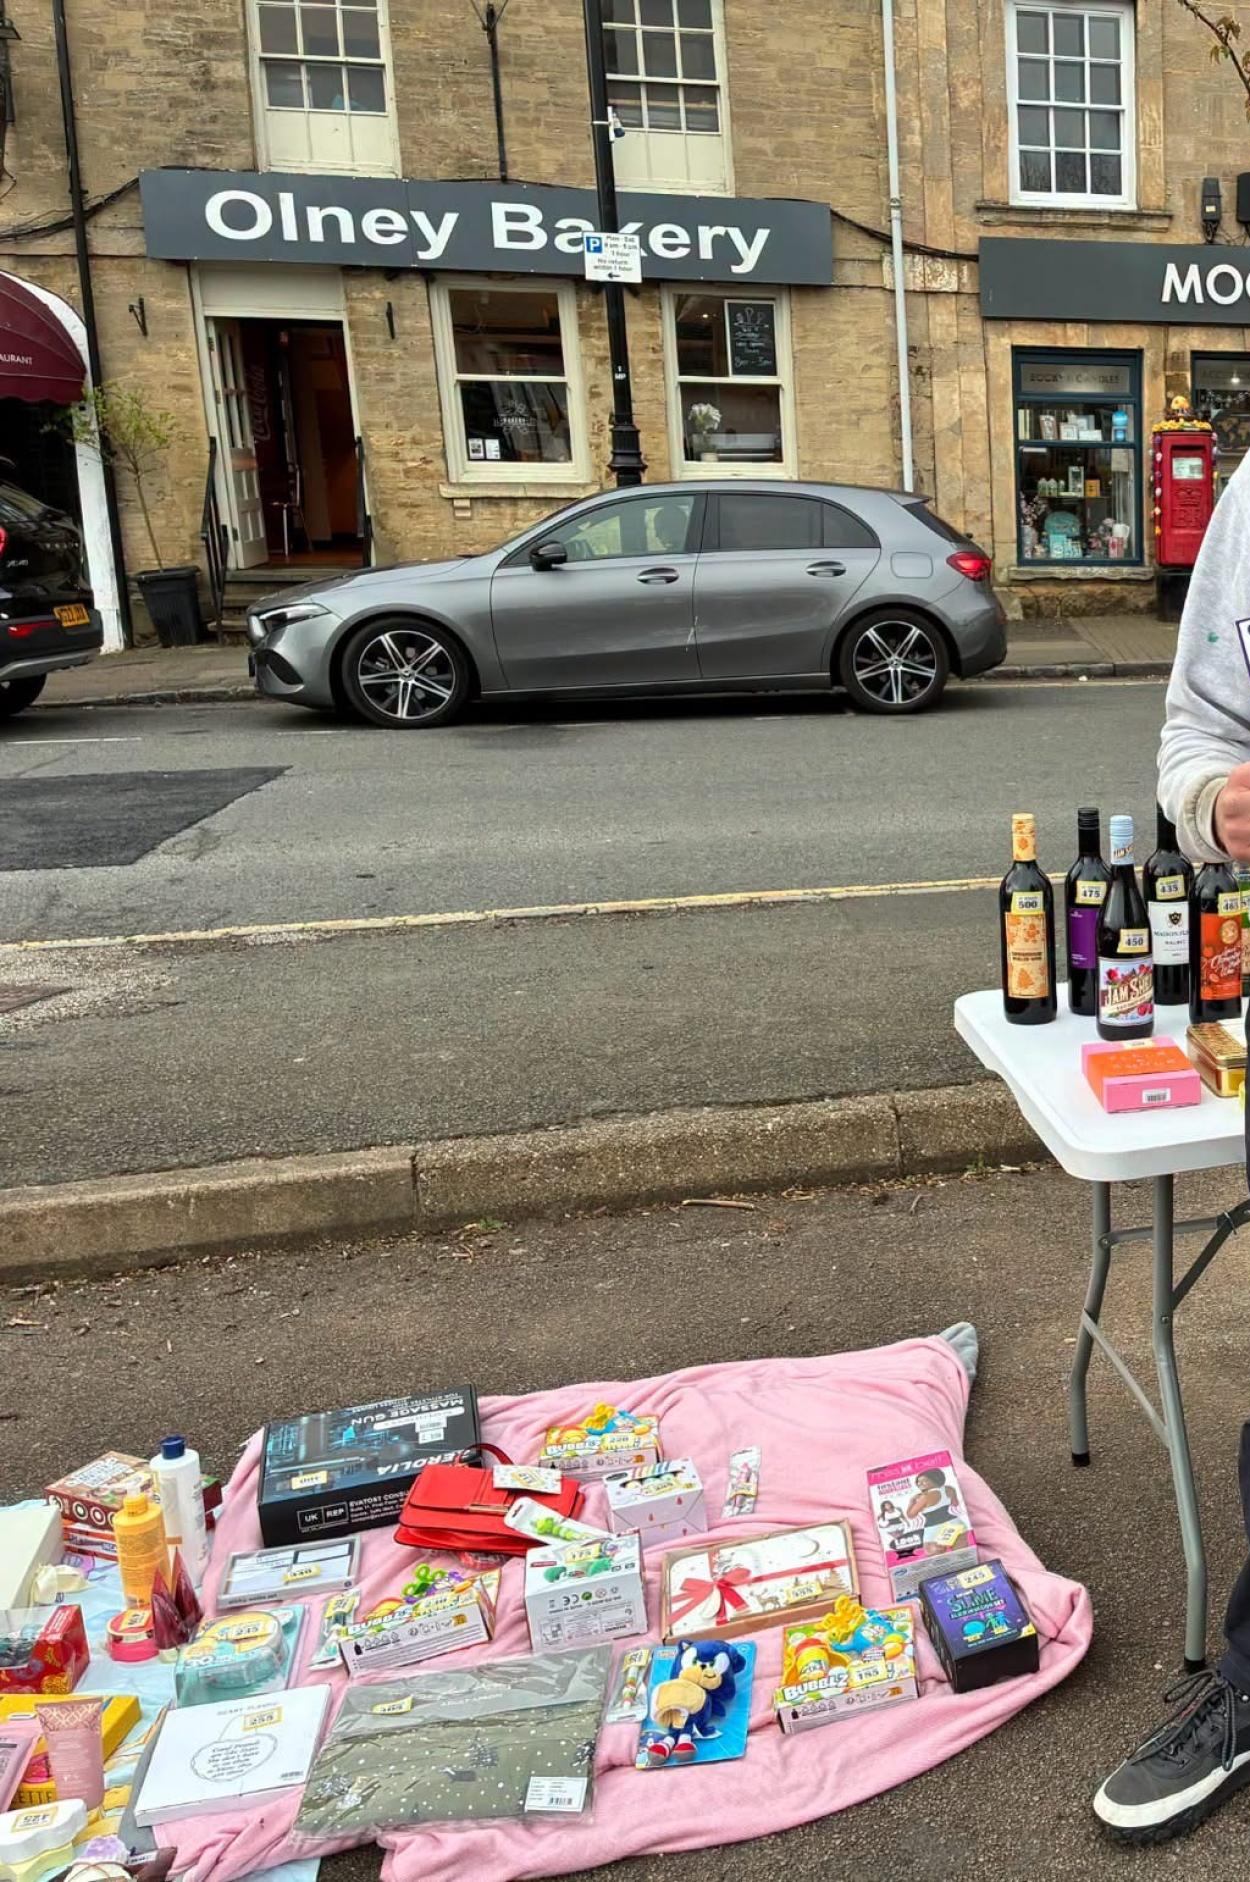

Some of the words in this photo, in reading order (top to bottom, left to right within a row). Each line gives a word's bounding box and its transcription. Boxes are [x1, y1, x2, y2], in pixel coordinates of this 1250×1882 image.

[205, 190, 460, 260] Olney
[1082, 890, 1100, 898] 475
[1018, 901, 1038, 909] 500
[1126, 937, 1144, 947] 450
[1105, 984, 1129, 1007] JAM
[389, 1398, 464, 1418] MASSAGE
[351, 1413, 388, 1426] GUN
[305, 1513, 318, 1523] UK
[326, 1507, 345, 1518] REP
